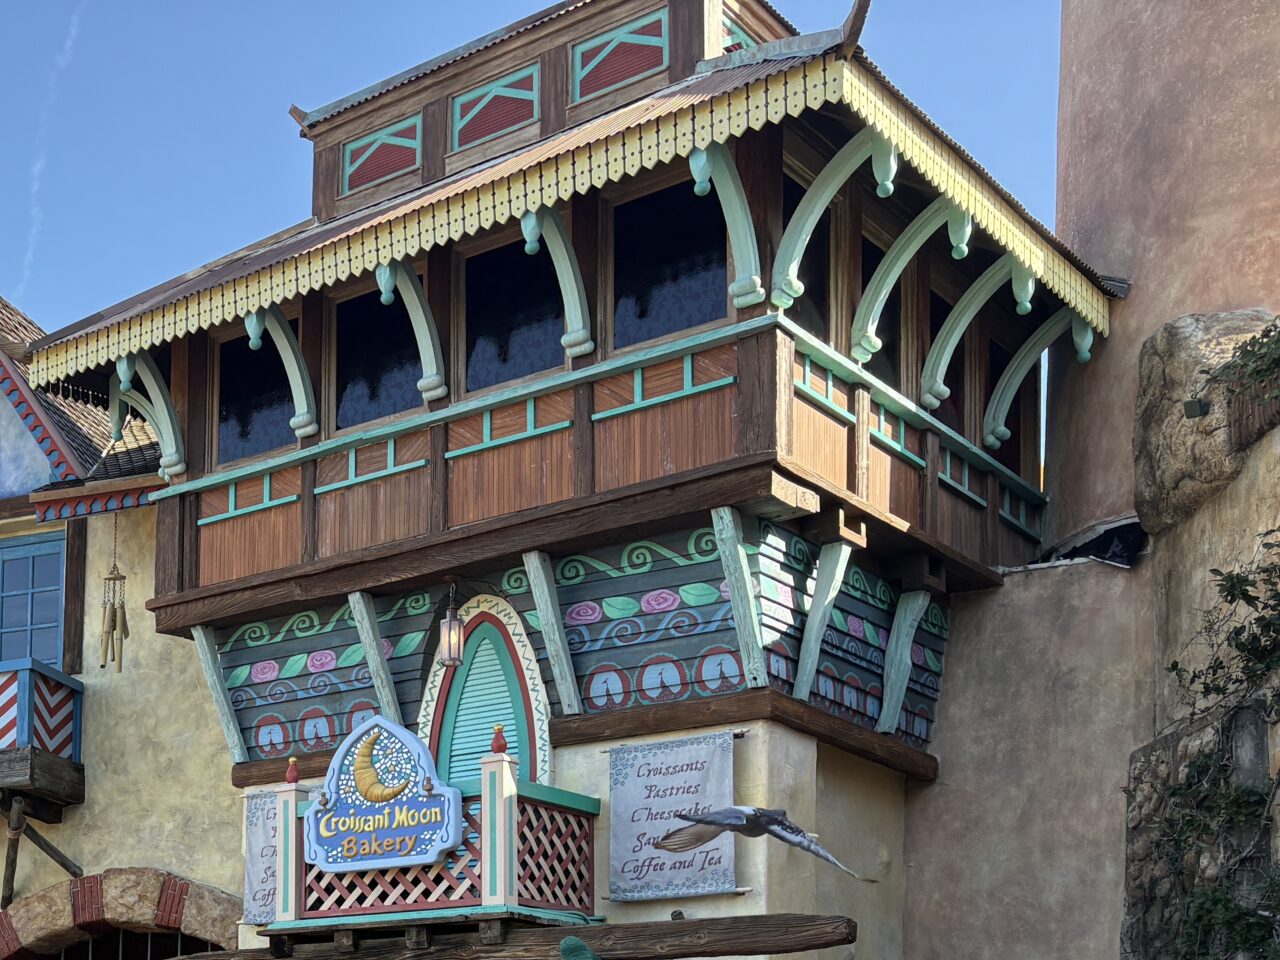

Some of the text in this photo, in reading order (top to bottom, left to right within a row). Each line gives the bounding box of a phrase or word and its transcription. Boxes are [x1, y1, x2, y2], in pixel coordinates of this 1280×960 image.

[637, 760, 707, 778] Croissants
[644, 781, 701, 799] Pastries
[320, 805, 442, 838] Croissant Moon
[342, 834, 418, 858] Bakery
[621, 848, 723, 880] Coffee and Tea
